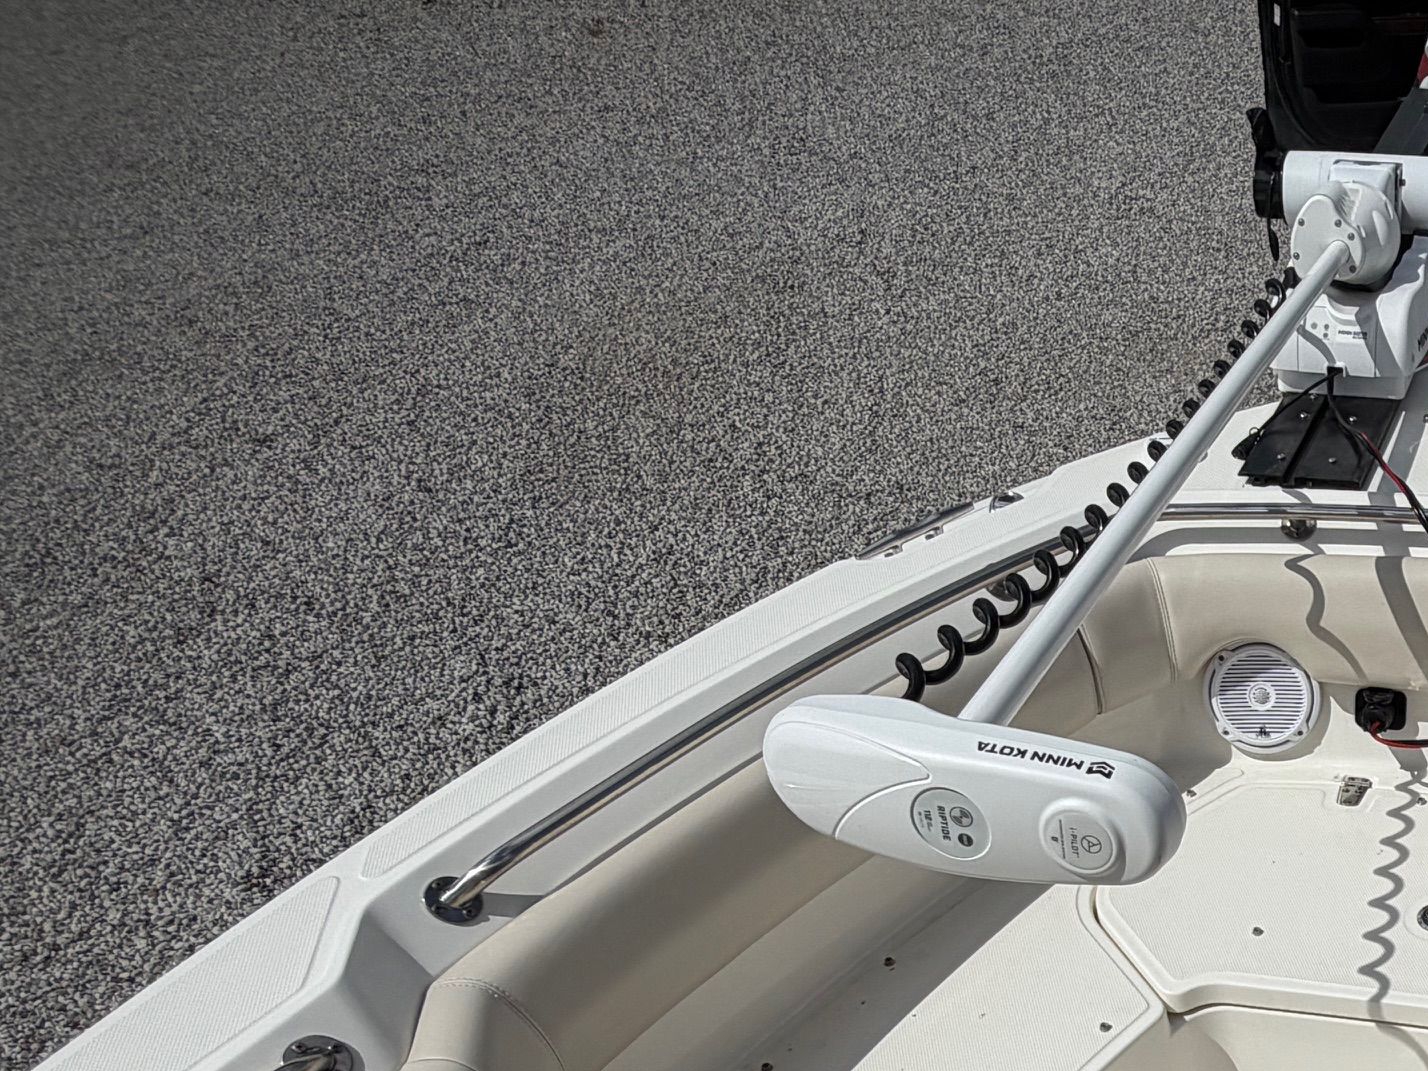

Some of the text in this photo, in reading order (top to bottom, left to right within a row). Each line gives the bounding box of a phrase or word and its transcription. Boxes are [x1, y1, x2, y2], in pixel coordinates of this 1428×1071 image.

[977, 740, 1085, 770] MINN KOTA
[936, 805, 952, 842] RIPTIDE
